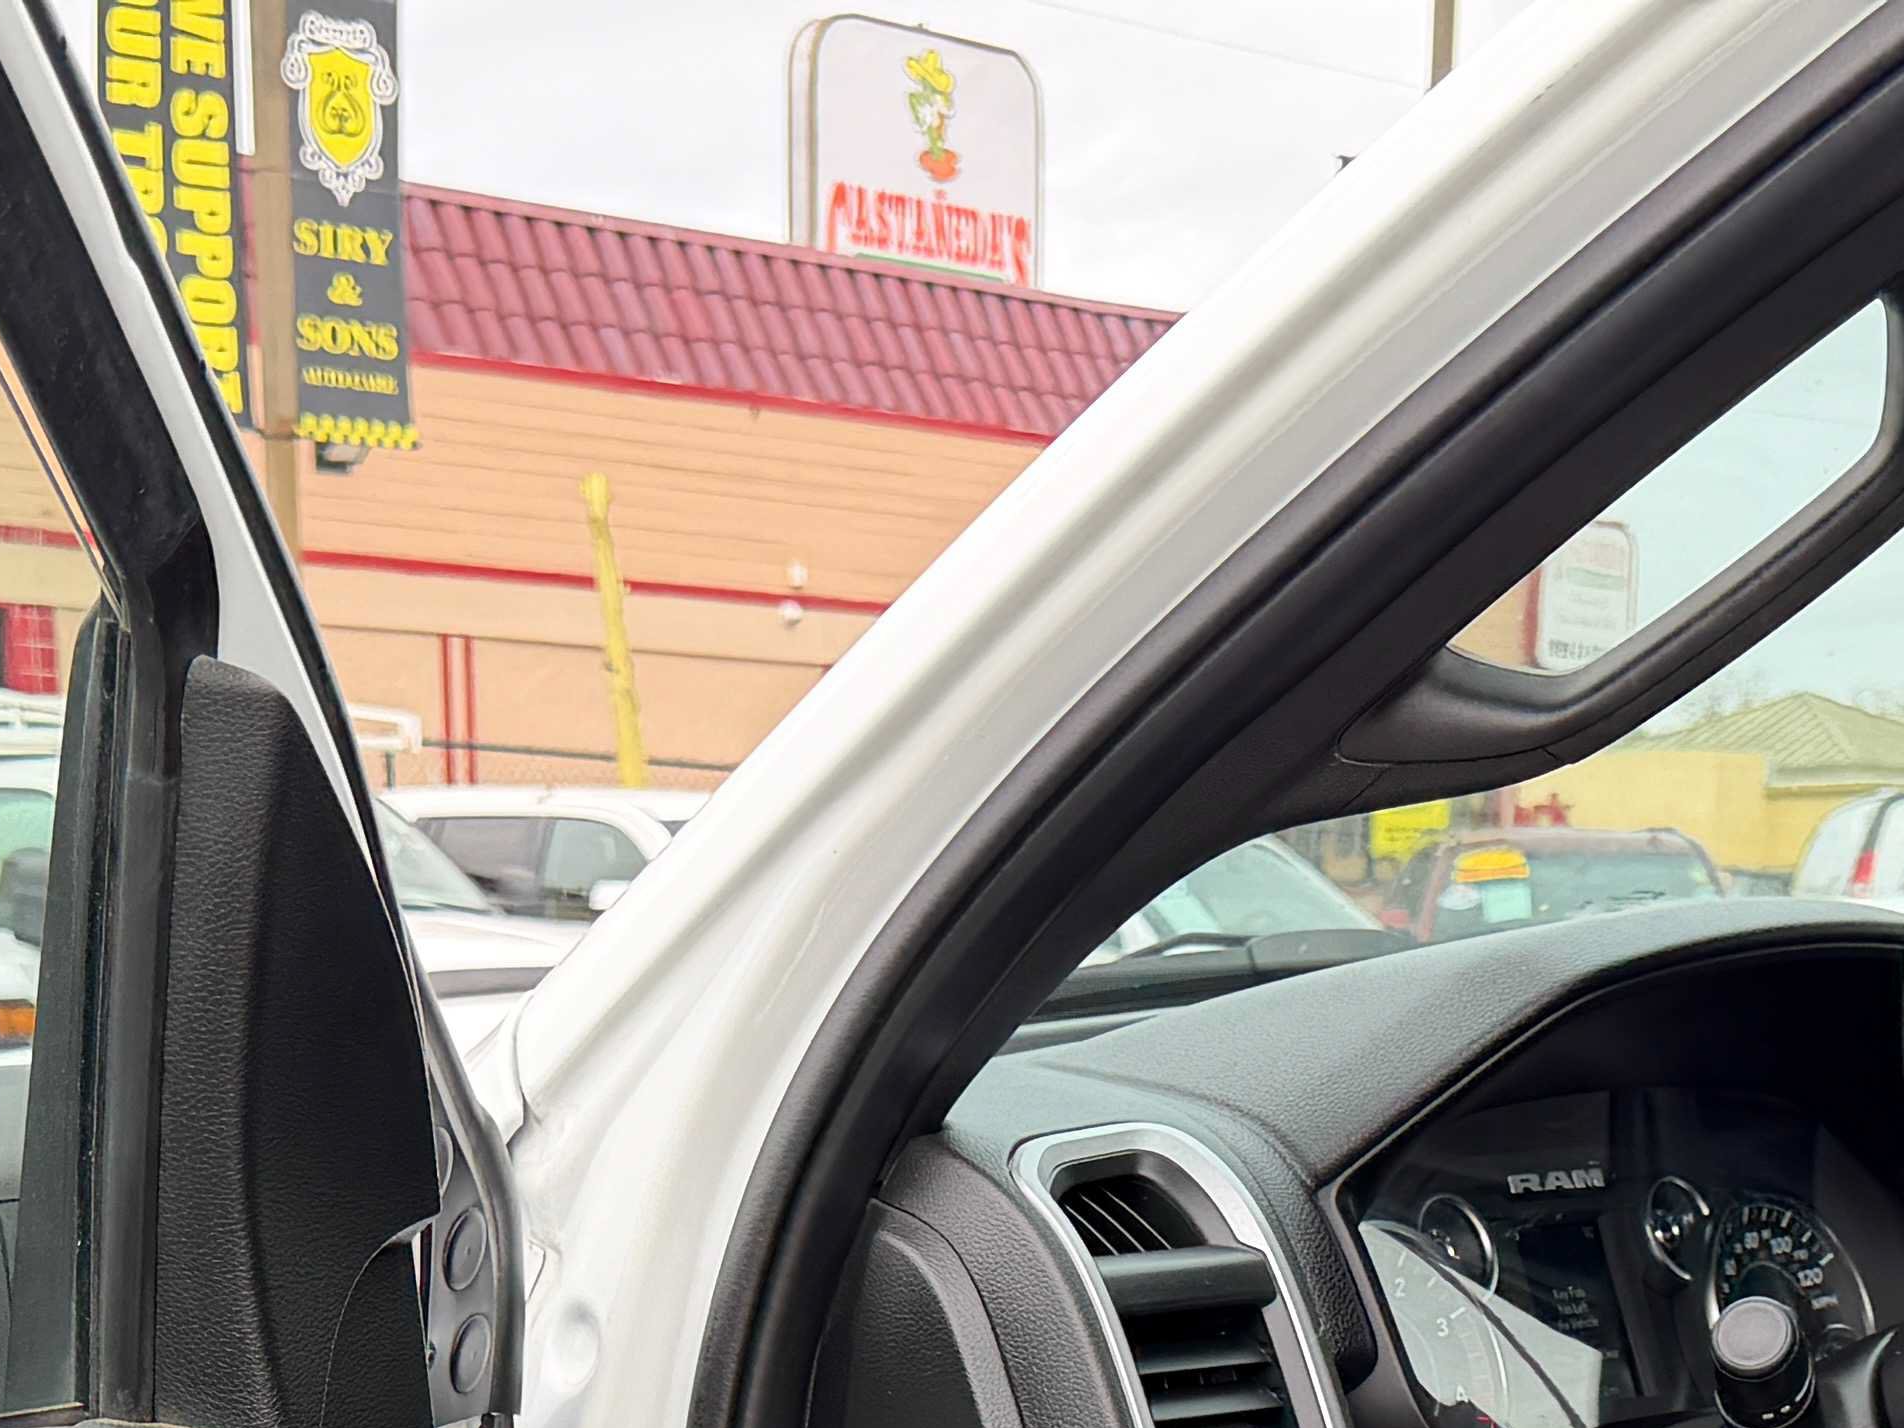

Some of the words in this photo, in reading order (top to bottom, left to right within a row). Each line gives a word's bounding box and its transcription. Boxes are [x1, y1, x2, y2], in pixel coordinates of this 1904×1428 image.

[293, 217, 394, 267] SIRY
[326, 271, 363, 307] &
[295, 312, 399, 361] SONS
[1507, 1166, 1606, 1196] RAM
[1392, 1276, 1407, 1298] 2
[1796, 1266, 1824, 1288] 120
[1435, 1316, 1450, 1338] 3
